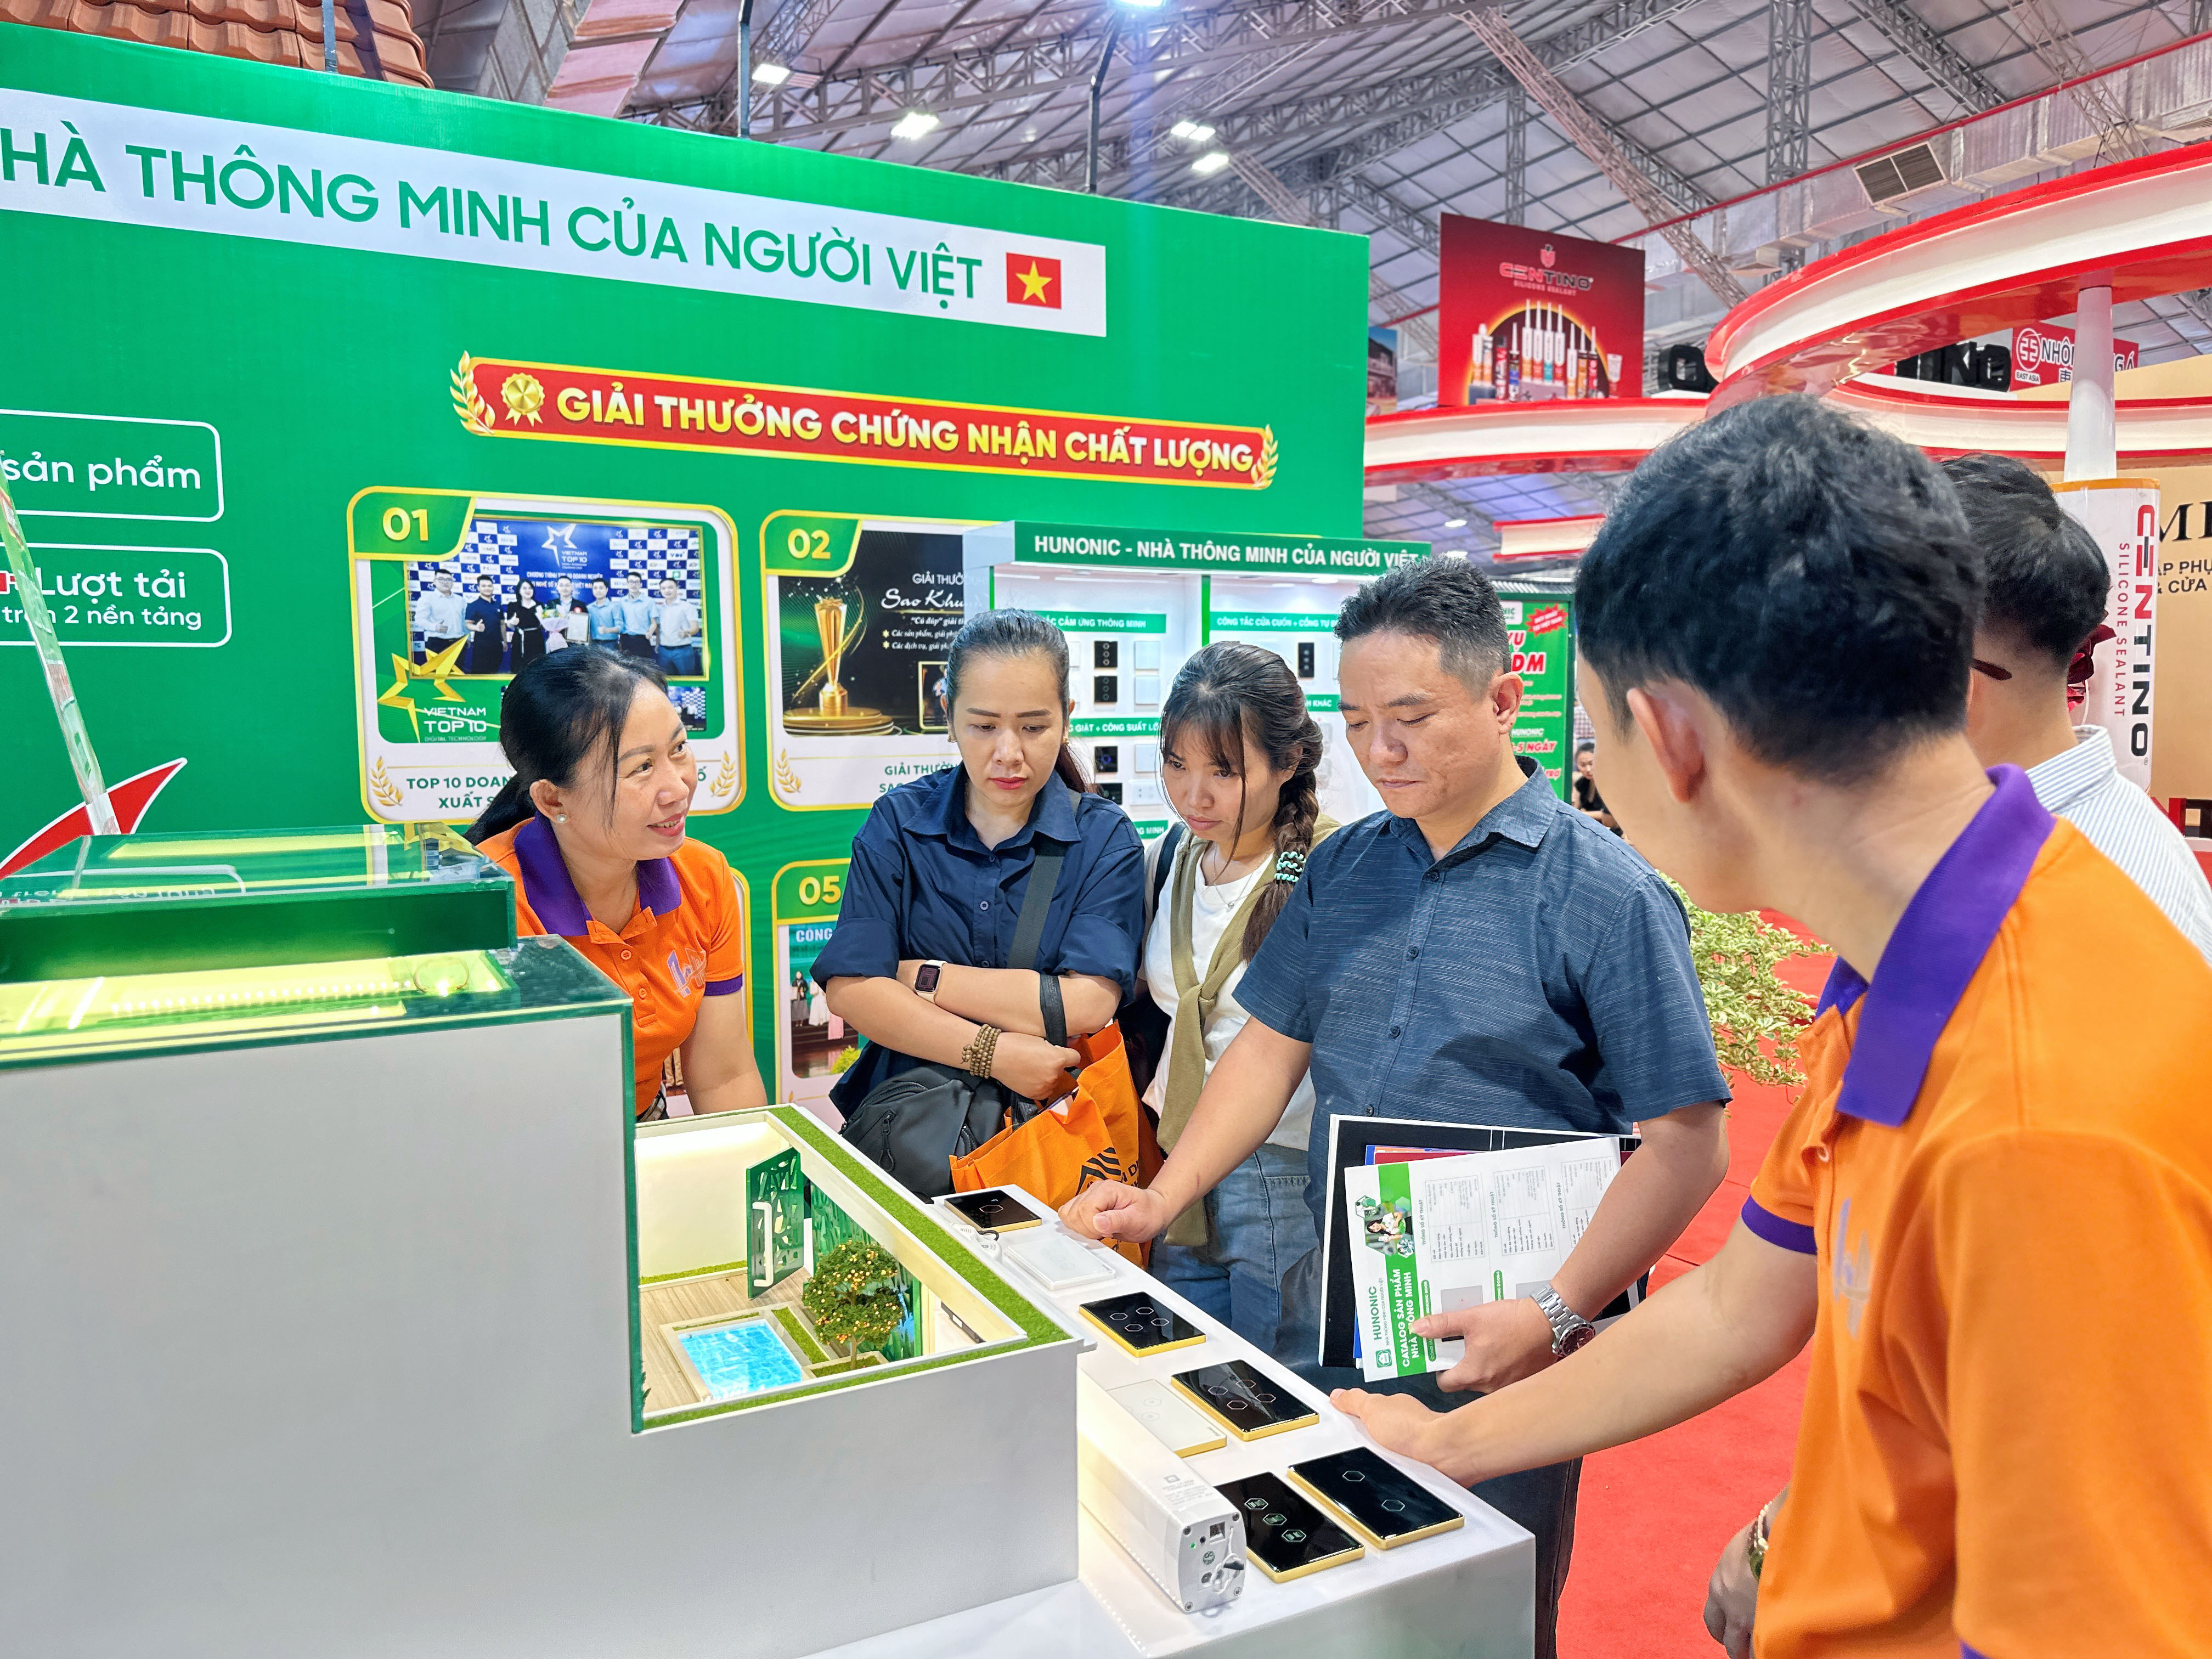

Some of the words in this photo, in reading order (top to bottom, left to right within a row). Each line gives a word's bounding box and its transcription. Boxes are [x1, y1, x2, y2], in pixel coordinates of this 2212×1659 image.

[126, 144, 379, 222] THÔNG
[399, 181, 549, 246] MINH
[568, 197, 688, 263] CỦA
[706, 223, 872, 285] NGƯỜI
[885, 242, 982, 308] VIỆT
[1499, 262, 1591, 290] CENTINO
[2041, 336, 2075, 366] NHÔ
[2016, 371, 2028, 380] EAST
[2029, 373, 2040, 382] ASIA
[557, 381, 645, 427] GIẢI
[654, 394, 822, 444] THƯỞNG
[832, 408, 958, 452] CHỨNG
[967, 420, 1056, 465] NHẬN
[1065, 425, 1147, 465] CHẤT
[1154, 438, 1254, 477] LƯỢNG
[2, 451, 74, 483] sản
[89, 455, 201, 492] phẩm
[383, 507, 429, 541] 01
[787, 528, 831, 559] 02
[1035, 535, 1121, 556] HUNONIC
[1137, 537, 1175, 560] NHÀ
[1180, 539, 1241, 562] THÔNG
[1245, 546, 1287, 564] MINH
[1292, 543, 1325, 566] CỦA
[1330, 548, 1380, 567] NGƯỜI
[35, 567, 122, 603] Lượt
[134, 569, 187, 599] tải
[912, 571, 935, 584] GIẢI
[2117, 542, 2130, 627] SILICONE
[2168, 576, 2208, 594] CỬA
[881, 588, 922, 609] Sao
[2, 606, 57, 624] trn
[64, 606, 79, 624] 2
[87, 603, 134, 625] nền
[141, 605, 201, 630] tảng
[1097, 618, 1125, 628] THÔNG
[1126, 620, 1147, 628] MINH
[1239, 616, 1254, 627] TÁC
[2131, 504, 2155, 757] CENTINO
[2114, 637, 2128, 717] SEALANT
[424, 707, 487, 716] VIETNAM
[424, 720, 465, 733] TOP
[466, 720, 487, 733] 10
[1102, 722, 1125, 732] CÔNG
[884, 761, 910, 775] GIẢI
[406, 777, 440, 789] TOP
[443, 777, 461, 788] 10
[438, 791, 483, 809] XUẤT
[798, 875, 842, 905] 05
[795, 929, 833, 943] CÔNG
[1389, 1268, 1402, 1297] PHẨM
[1403, 1272, 1413, 1297] MINH
[1368, 1286, 1382, 1340] HUNONIC
[1393, 1299, 1404, 1319] SẢN
[1406, 1299, 1415, 1335] ÔNG
[1398, 1321, 1410, 1367] CATALOG
[1408, 1336, 1419, 1358] NHÀ
